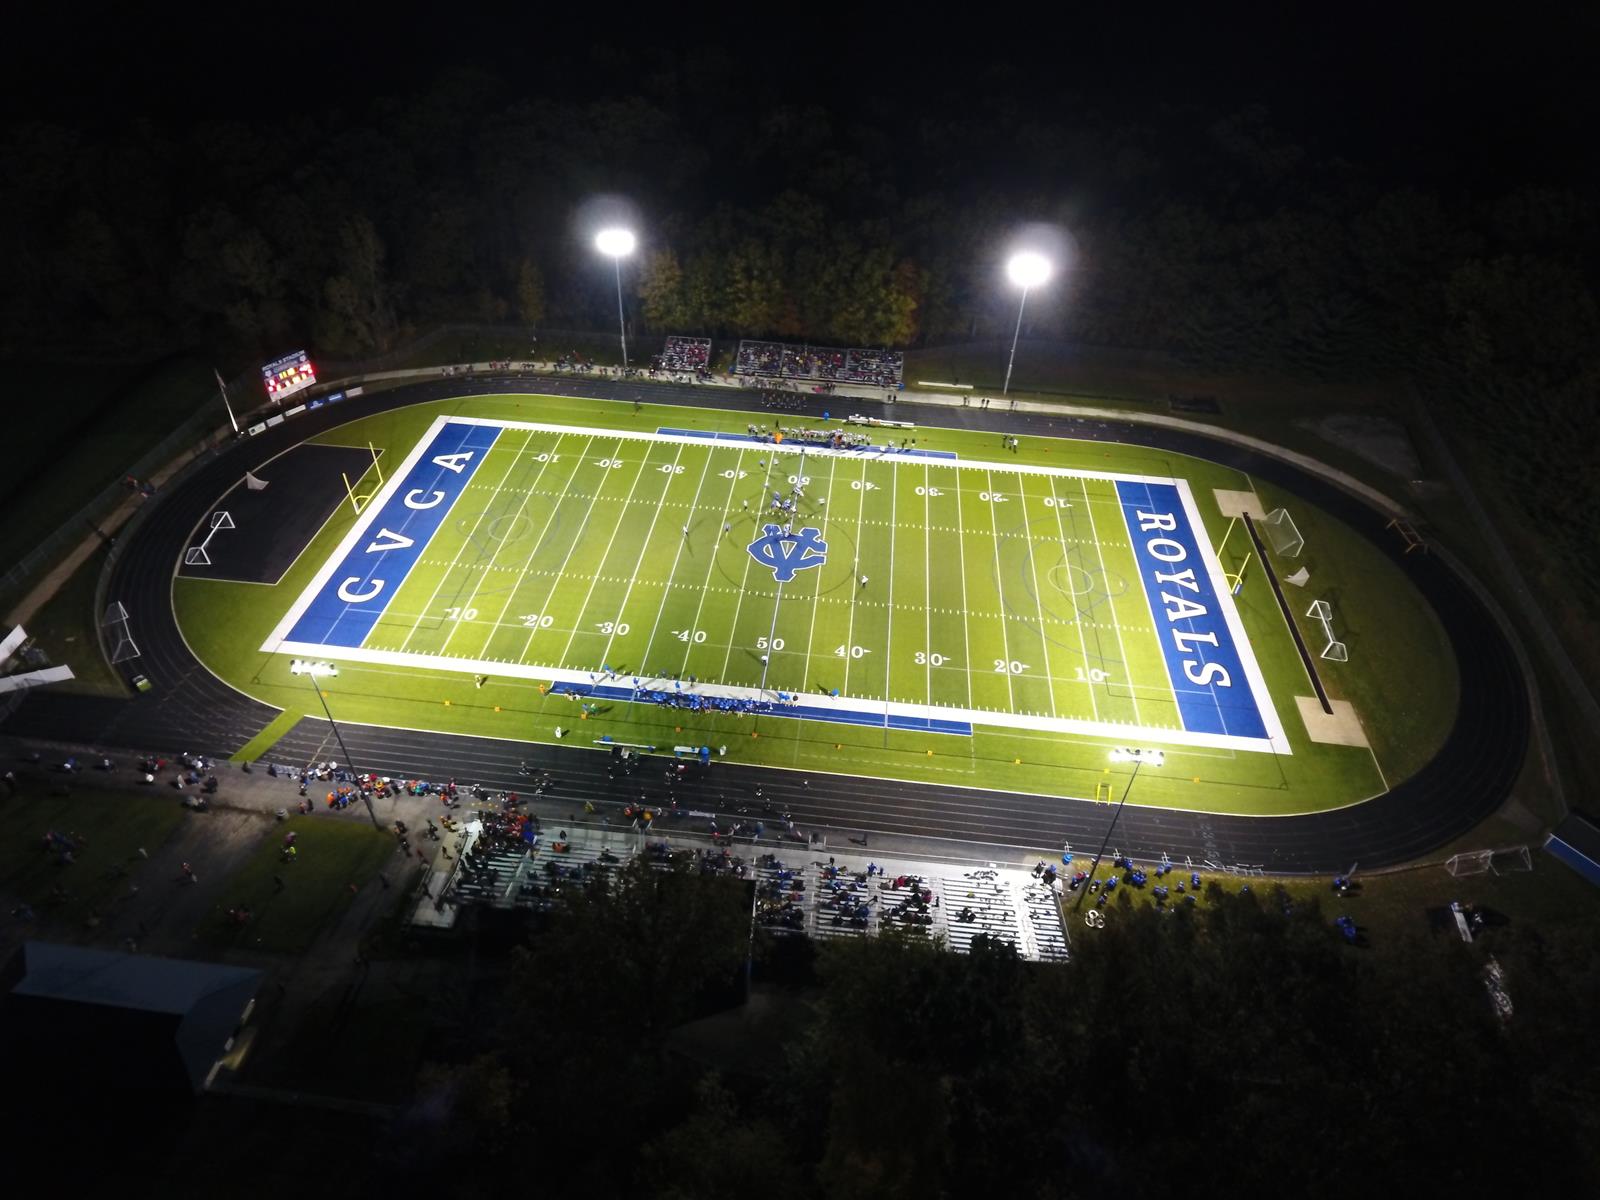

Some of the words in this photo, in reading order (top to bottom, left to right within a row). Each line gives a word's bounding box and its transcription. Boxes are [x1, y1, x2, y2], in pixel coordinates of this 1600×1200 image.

[537, 453, 560, 463] 10
[599, 459, 624, 469] 20
[662, 464, 686, 474] 30
[724, 469, 748, 480] 40
[787, 475, 811, 486] 50
[850, 480, 876, 491] 40
[914, 486, 939, 497] 30
[979, 492, 1003, 503] 20
[1043, 497, 1068, 508] 10
[1136, 509, 1232, 688] ROYALS
[448, 608, 478, 621] 10
[523, 614, 554, 627] 20
[601, 622, 631, 636] 30
[677, 629, 707, 644] 40
[756, 637, 786, 651] 50
[834, 644, 865, 659] 40
[914, 651, 944, 667] 30
[993, 658, 1023, 674] 20
[1074, 666, 1104, 682] 10
